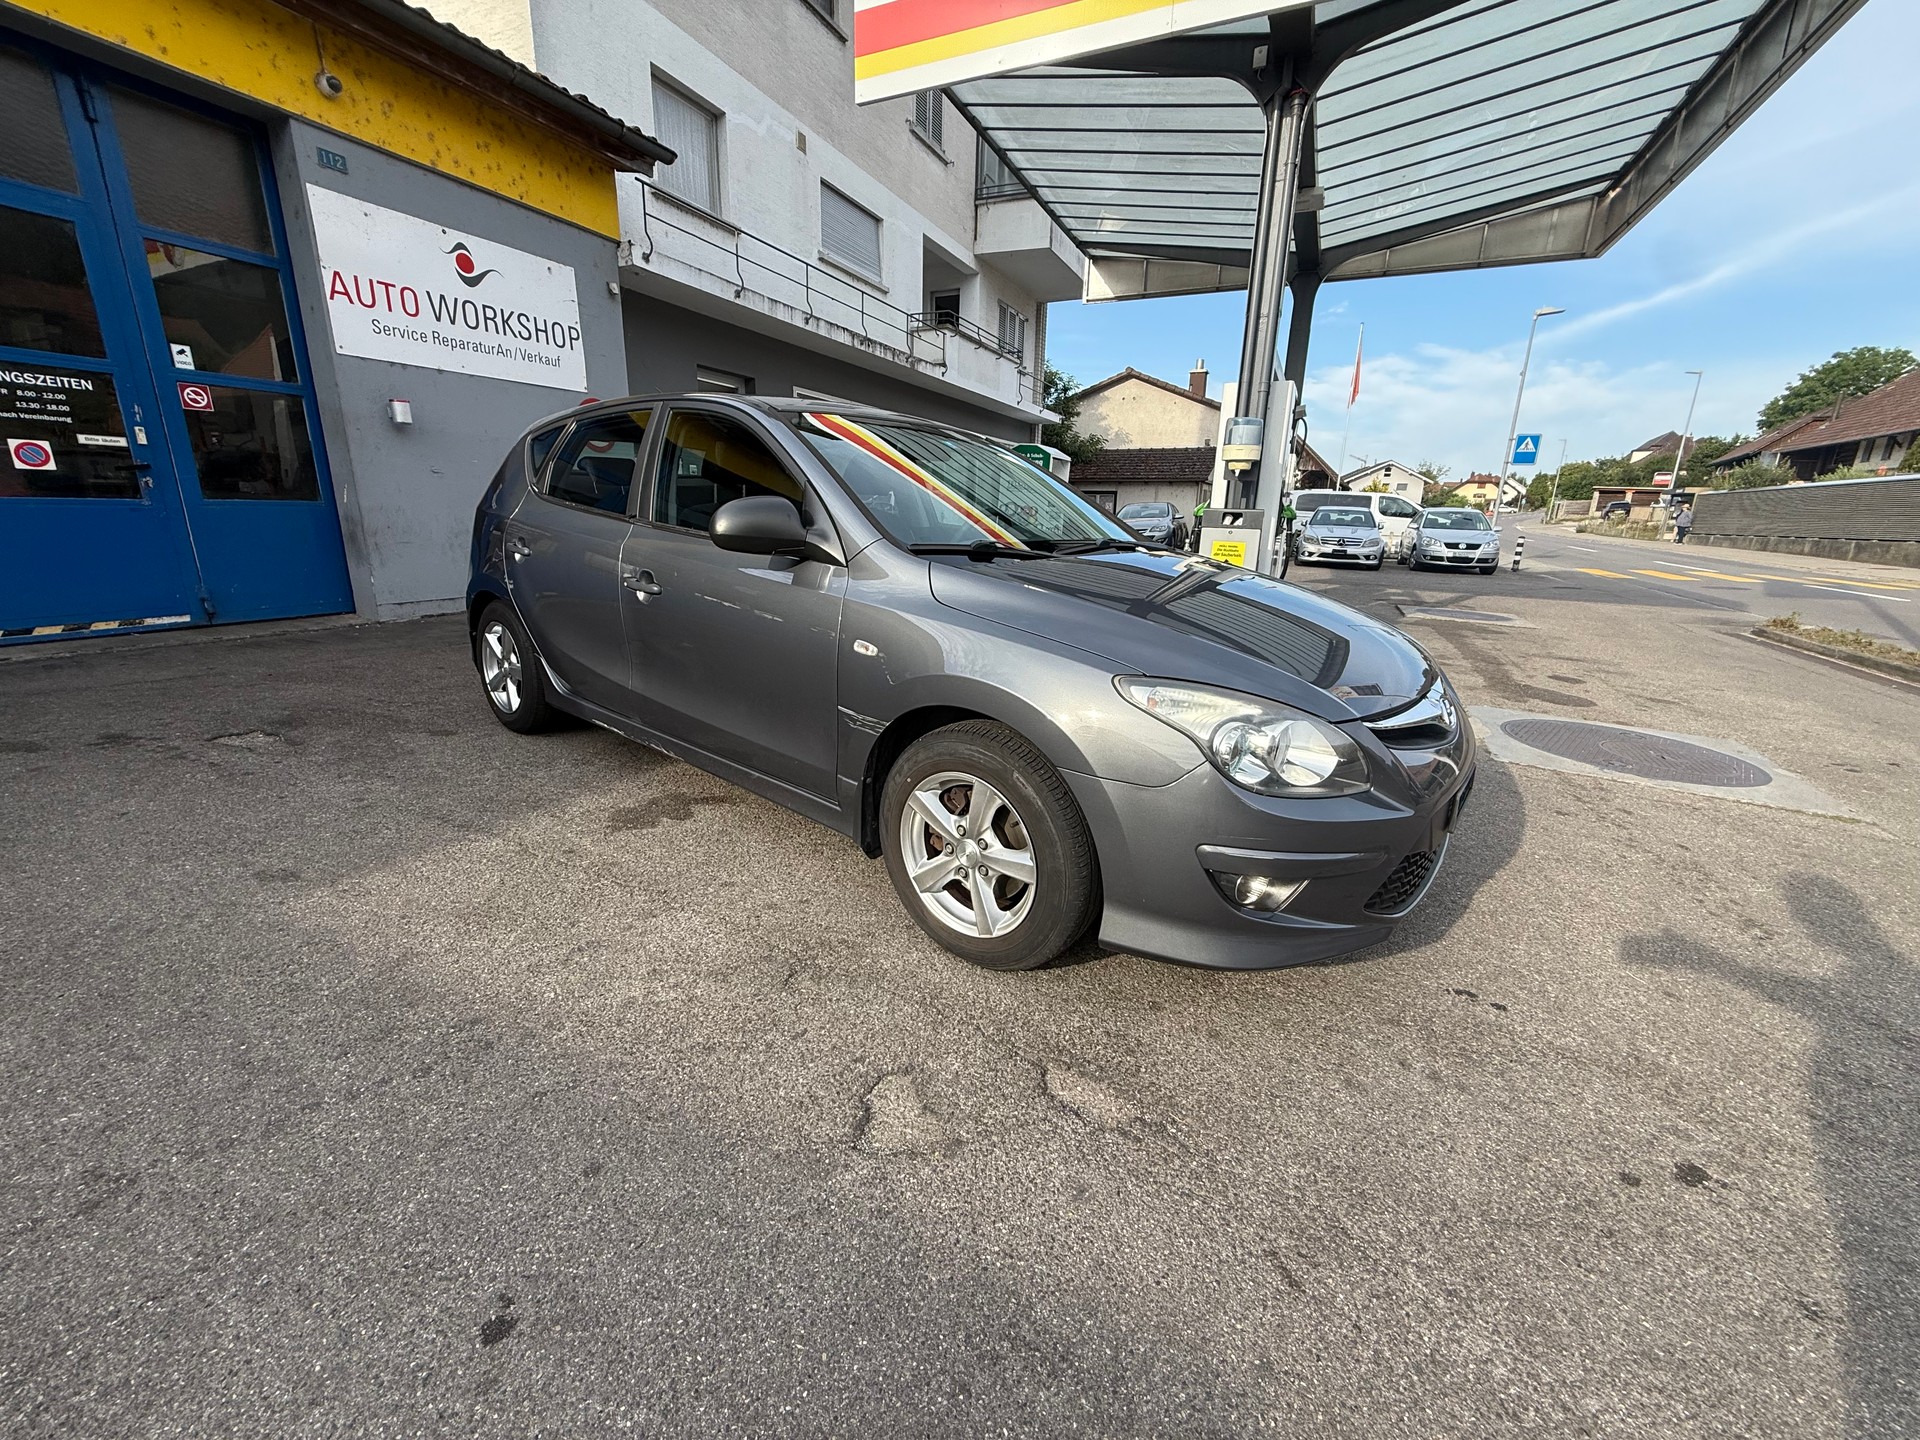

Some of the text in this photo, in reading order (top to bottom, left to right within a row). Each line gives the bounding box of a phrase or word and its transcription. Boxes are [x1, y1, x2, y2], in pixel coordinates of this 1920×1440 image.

[320, 150, 344, 169] 112
[329, 270, 580, 351] AUTO WORKSHOP
[371, 318, 428, 343] Service
[16, 389, 36, 397] 8.00
[42, 392, 66, 400] 12.00
[18, 412, 72, 423] Vereinbarung
